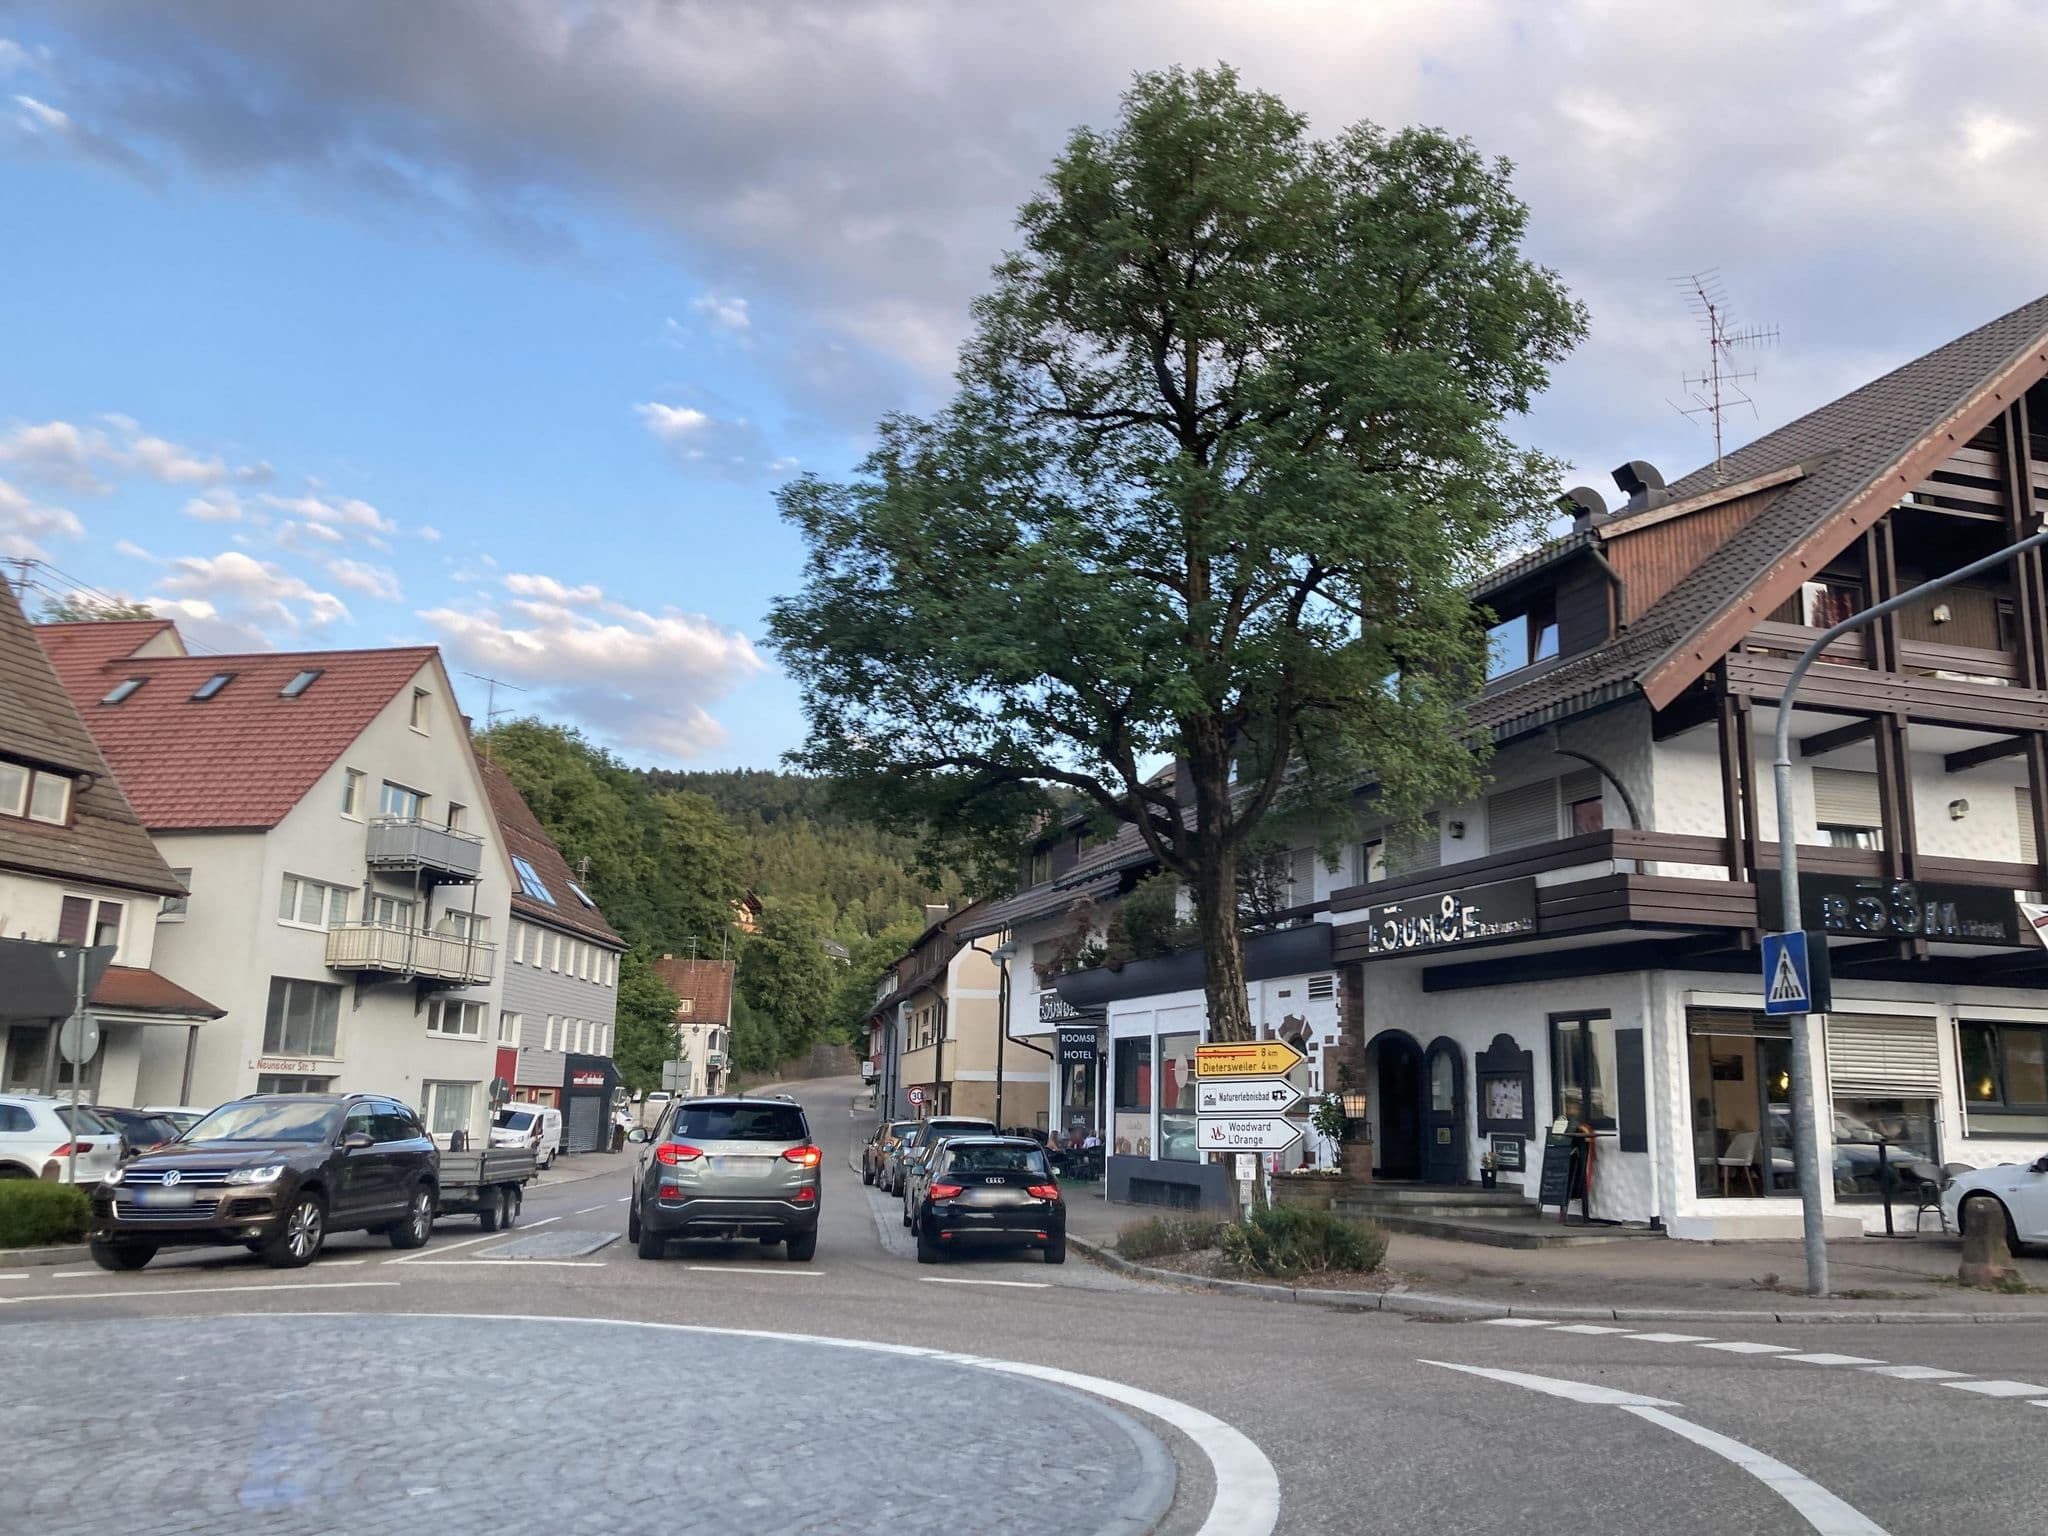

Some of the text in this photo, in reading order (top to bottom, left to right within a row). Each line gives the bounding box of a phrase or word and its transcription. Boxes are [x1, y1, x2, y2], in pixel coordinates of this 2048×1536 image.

[1063, 1050, 1093, 1059] HOTEL
[1261, 1047, 1266, 1057] 8
[256, 1060, 295, 1071] Neunecker
[297, 1061, 309, 1072] Str.
[311, 1062, 316, 1072] 3
[1203, 1061, 1278, 1073] Dietersweiler 4 km
[911, 1092, 922, 1100] 30
[1219, 1091, 1270, 1102] Naturerlebnisbad
[1228, 1121, 1271, 1132] Woodward
[1228, 1135, 1263, 1146] L'Orange
